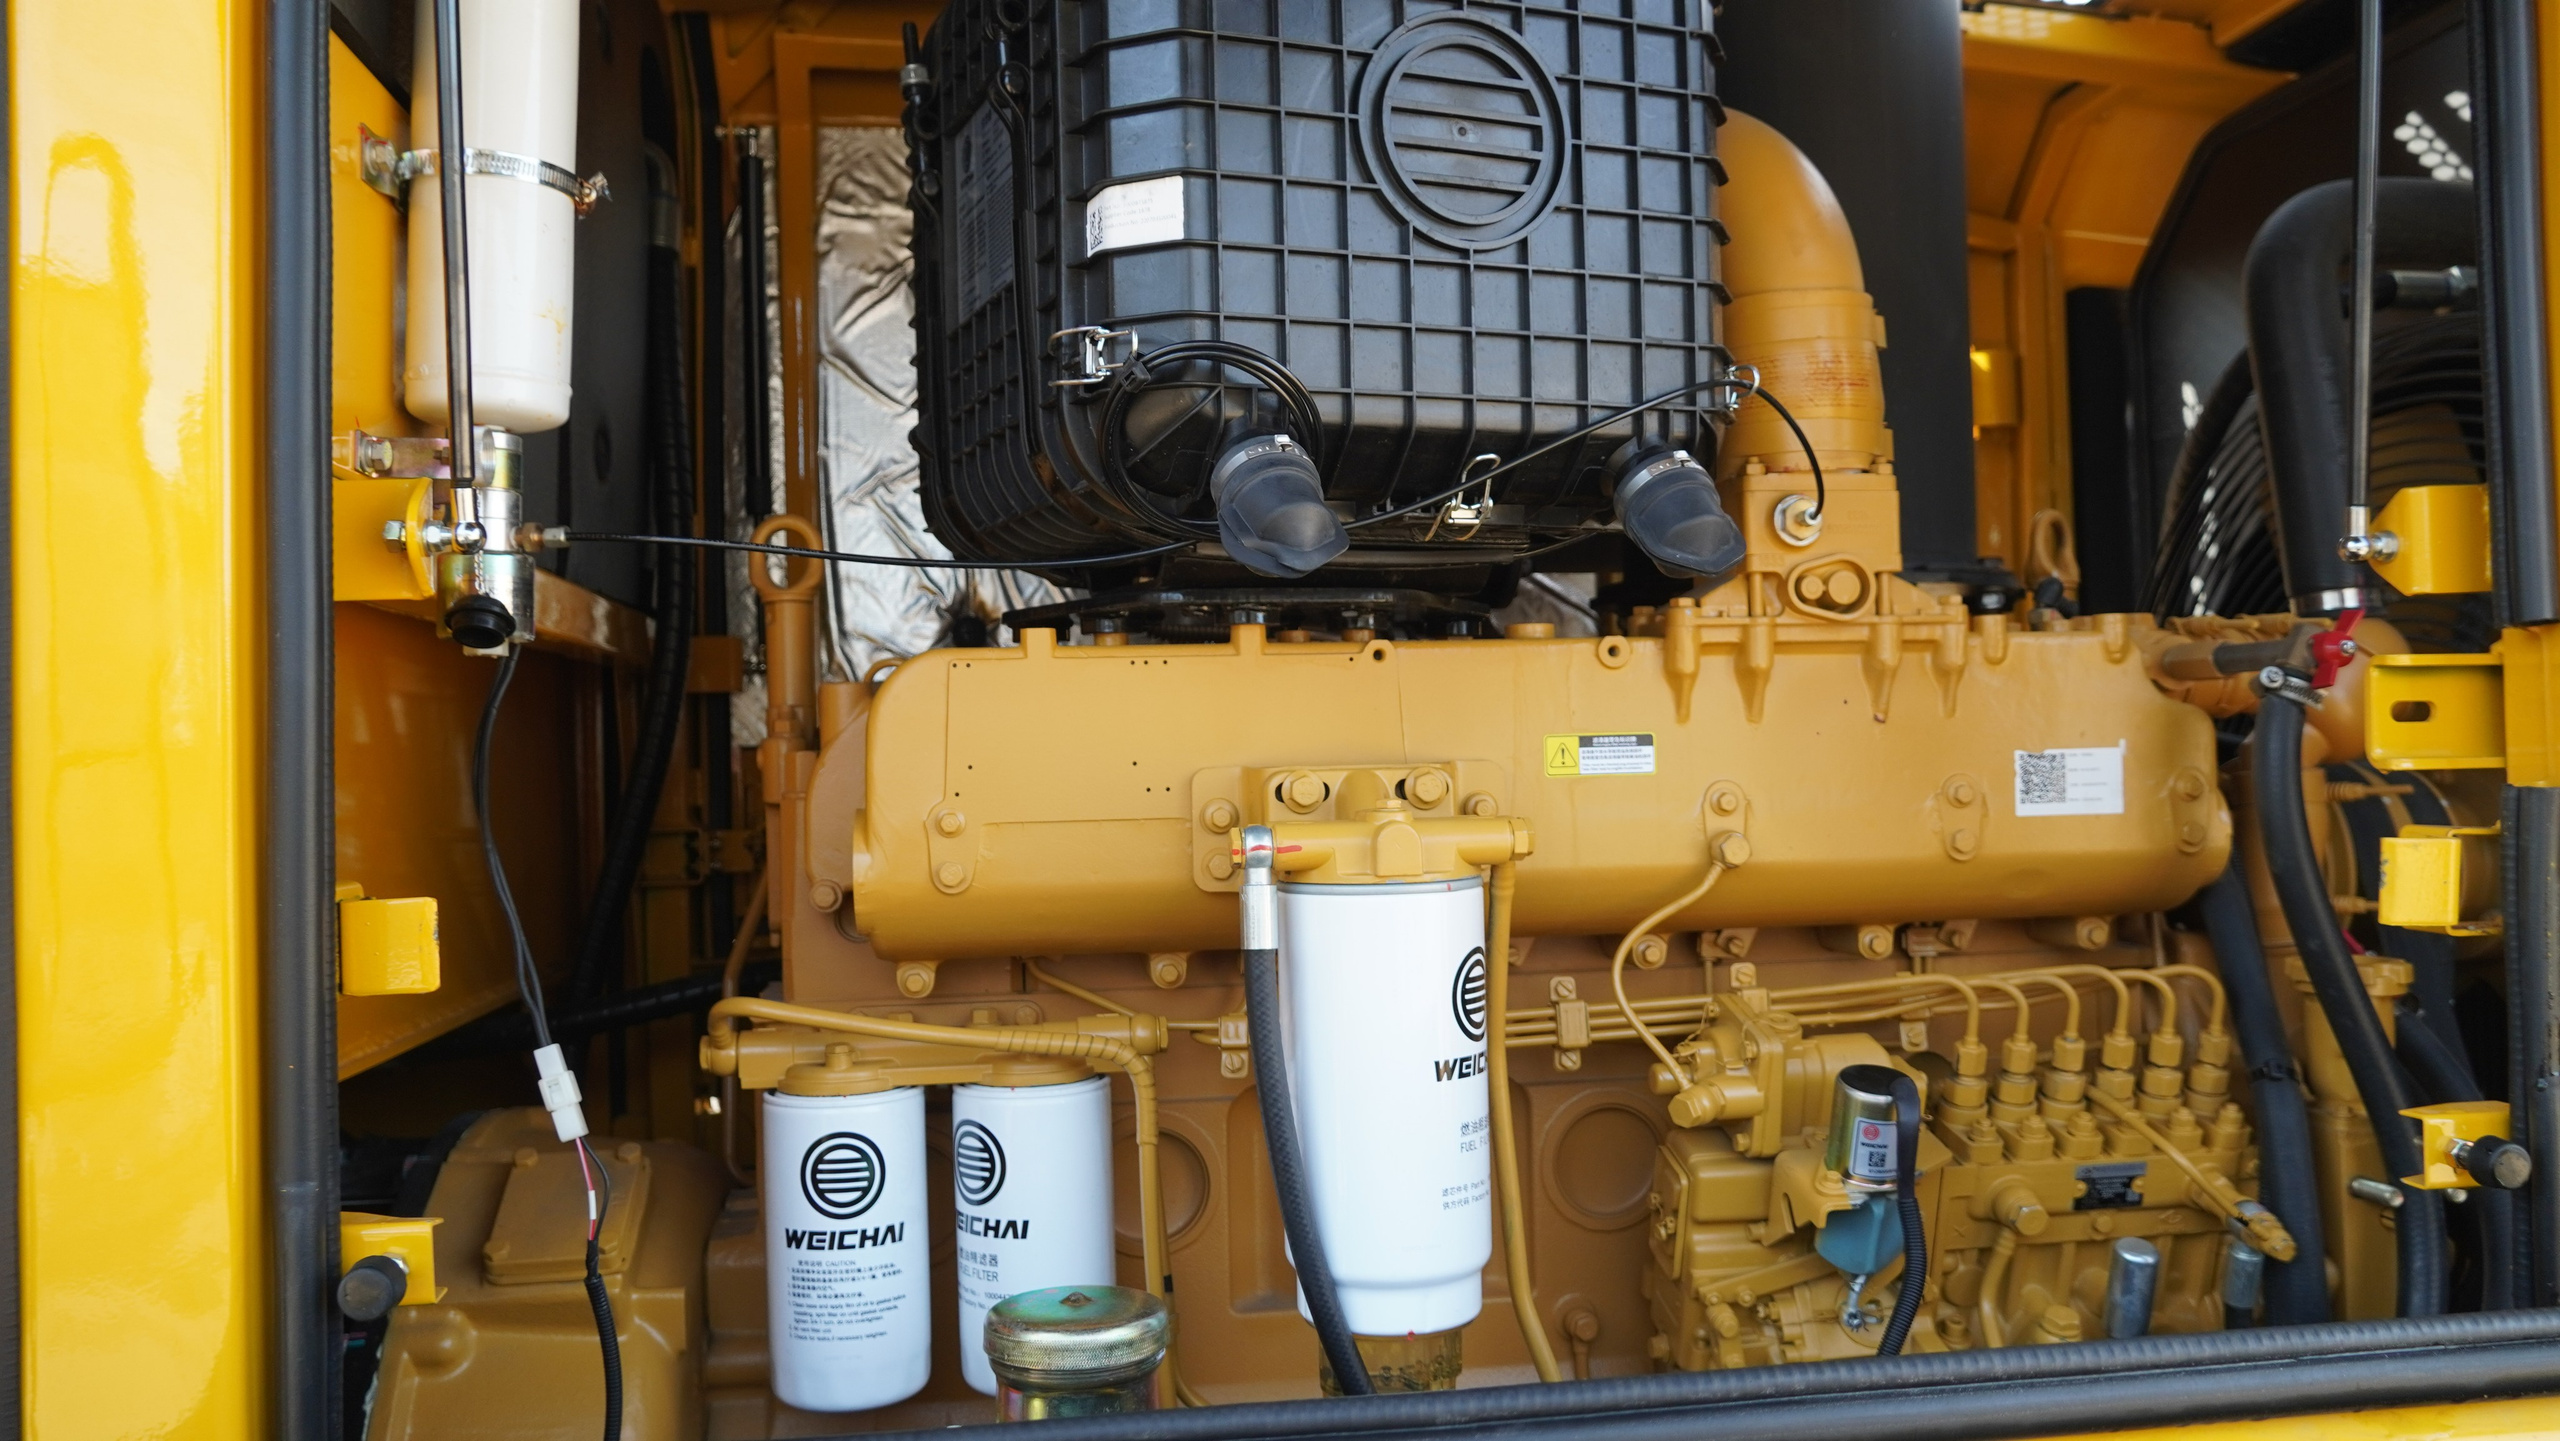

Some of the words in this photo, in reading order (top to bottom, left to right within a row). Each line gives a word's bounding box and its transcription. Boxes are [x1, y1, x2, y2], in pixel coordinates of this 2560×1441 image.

[1460, 1139, 1478, 1153] FUEL
[956, 1211, 1029, 1240] EICHAI
[785, 1222, 904, 1250] WEICHAI
[825, 1259, 857, 1267] CAUTION
[972, 1267, 999, 1282] FILTER
